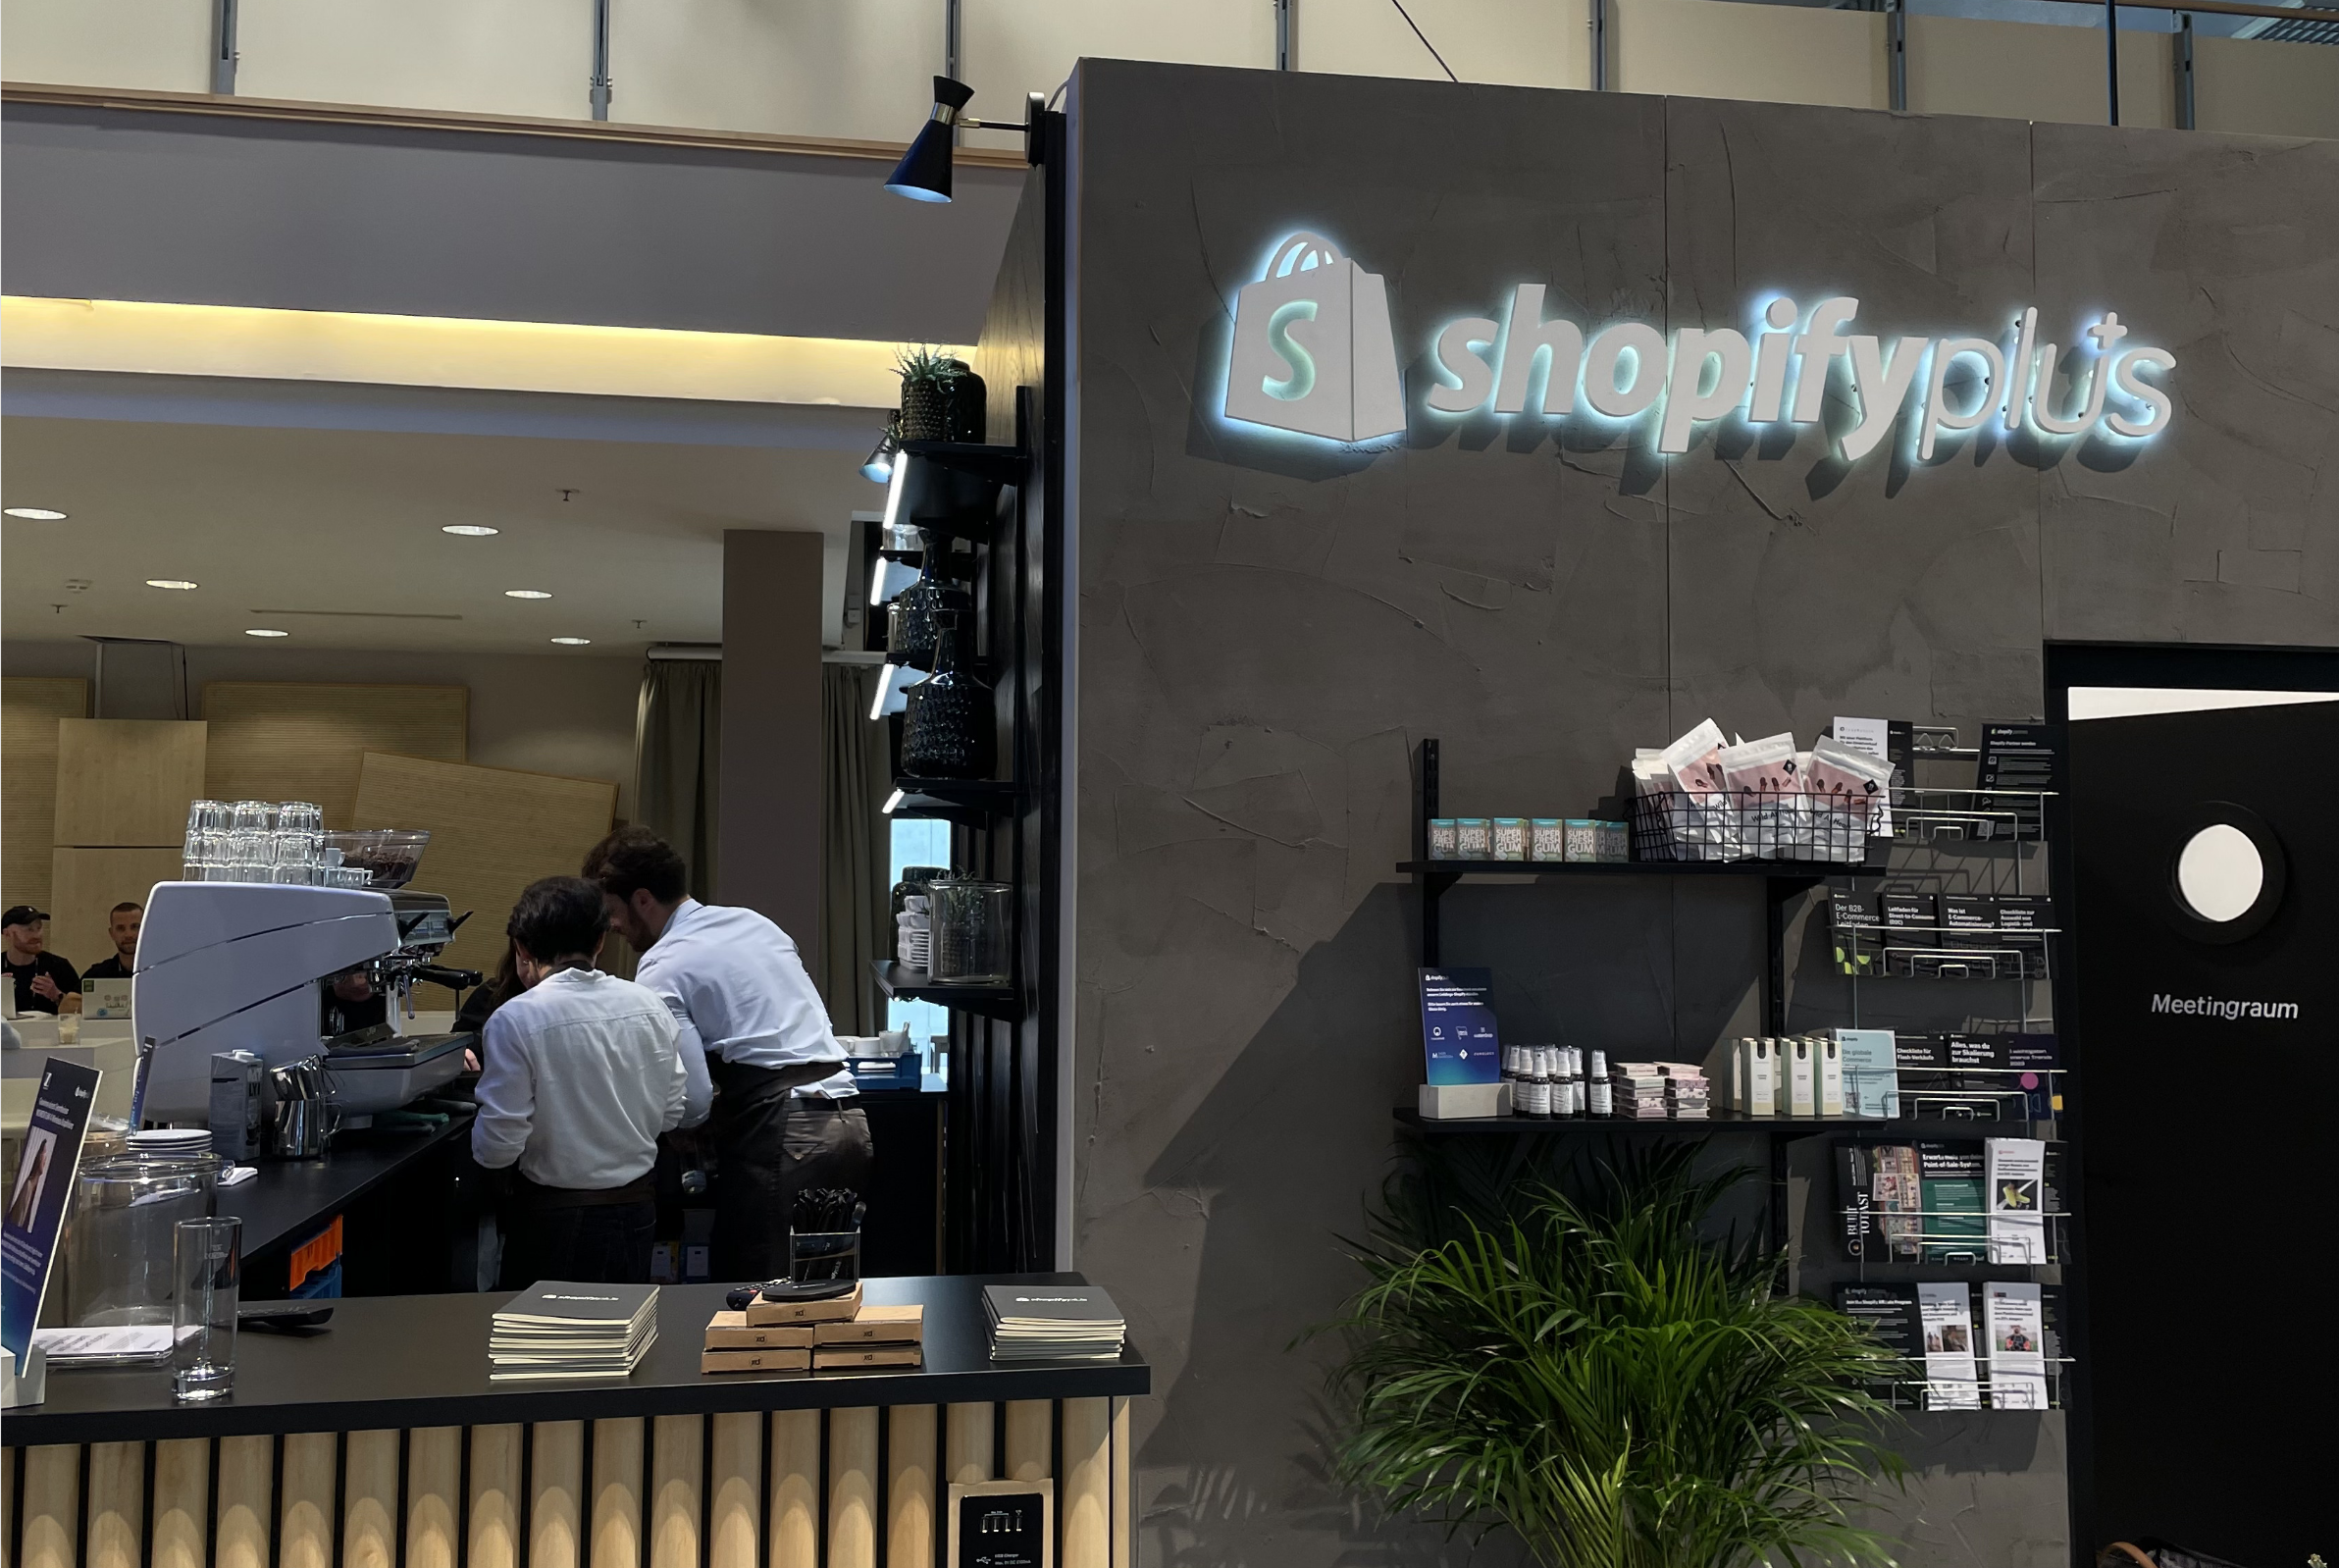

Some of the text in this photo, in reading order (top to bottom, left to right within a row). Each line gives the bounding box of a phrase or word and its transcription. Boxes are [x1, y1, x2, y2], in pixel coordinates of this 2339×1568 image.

[1459, 843, 1485, 852] GUM
[1496, 843, 1522, 852] GUM
[1534, 844, 1560, 853] GUM
[1567, 844, 1593, 853] GUM
[2151, 993, 2299, 1020] Meetingraum
[1962, 1049, 1995, 1058] Skalierung
